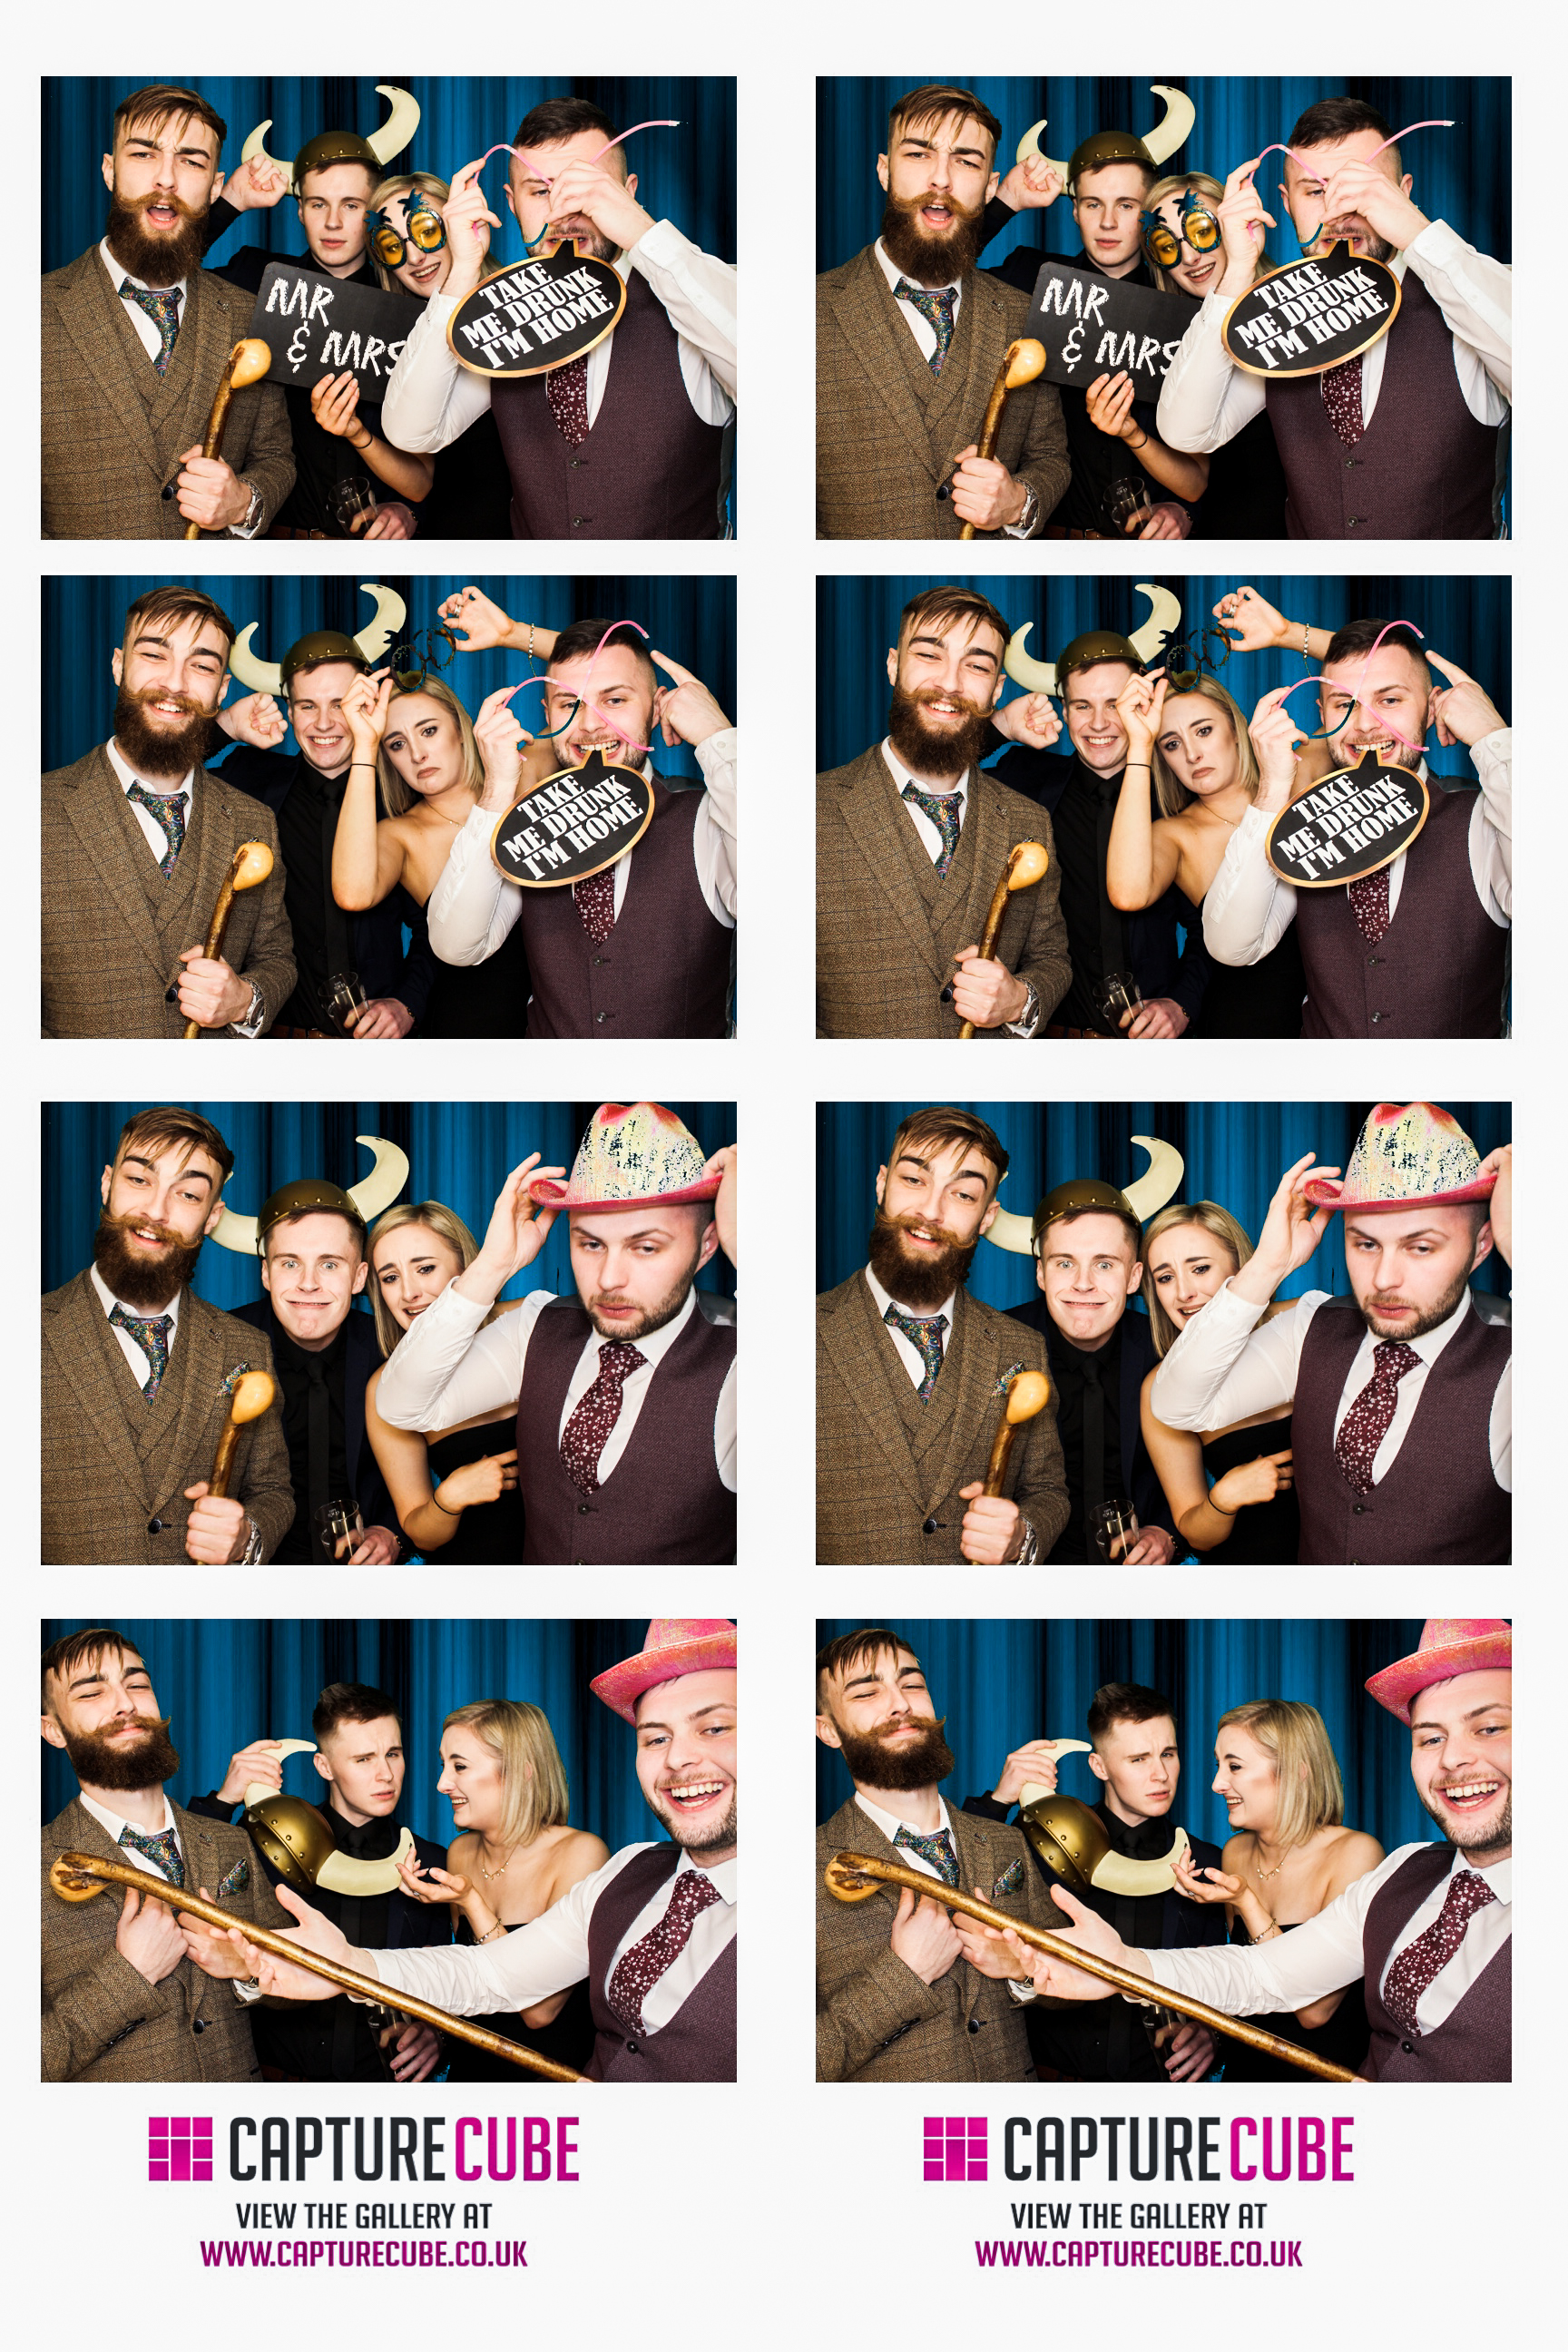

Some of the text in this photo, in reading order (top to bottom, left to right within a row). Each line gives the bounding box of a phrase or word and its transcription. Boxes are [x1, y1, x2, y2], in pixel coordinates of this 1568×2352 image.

[265, 277, 335, 327] MR
[460, 266, 603, 349] ME DRUNK
[478, 263, 554, 309] TAKE
[1040, 277, 1110, 327] MR
[1235, 266, 1377, 349] ME DRUNK
[1253, 263, 1328, 309] TAKE
[286, 320, 310, 374] &
[480, 289, 614, 369] I'M HOME
[1061, 320, 1085, 374] &
[1255, 289, 1389, 369] I'M HOME
[502, 775, 632, 863] ME DRUNK
[516, 775, 585, 824] TAKE
[1277, 775, 1406, 863] ME DRUNK
[1291, 775, 1360, 824] TAKE
[522, 796, 644, 881] I'M HOME
[1297, 796, 1419, 881] I'M HOME
